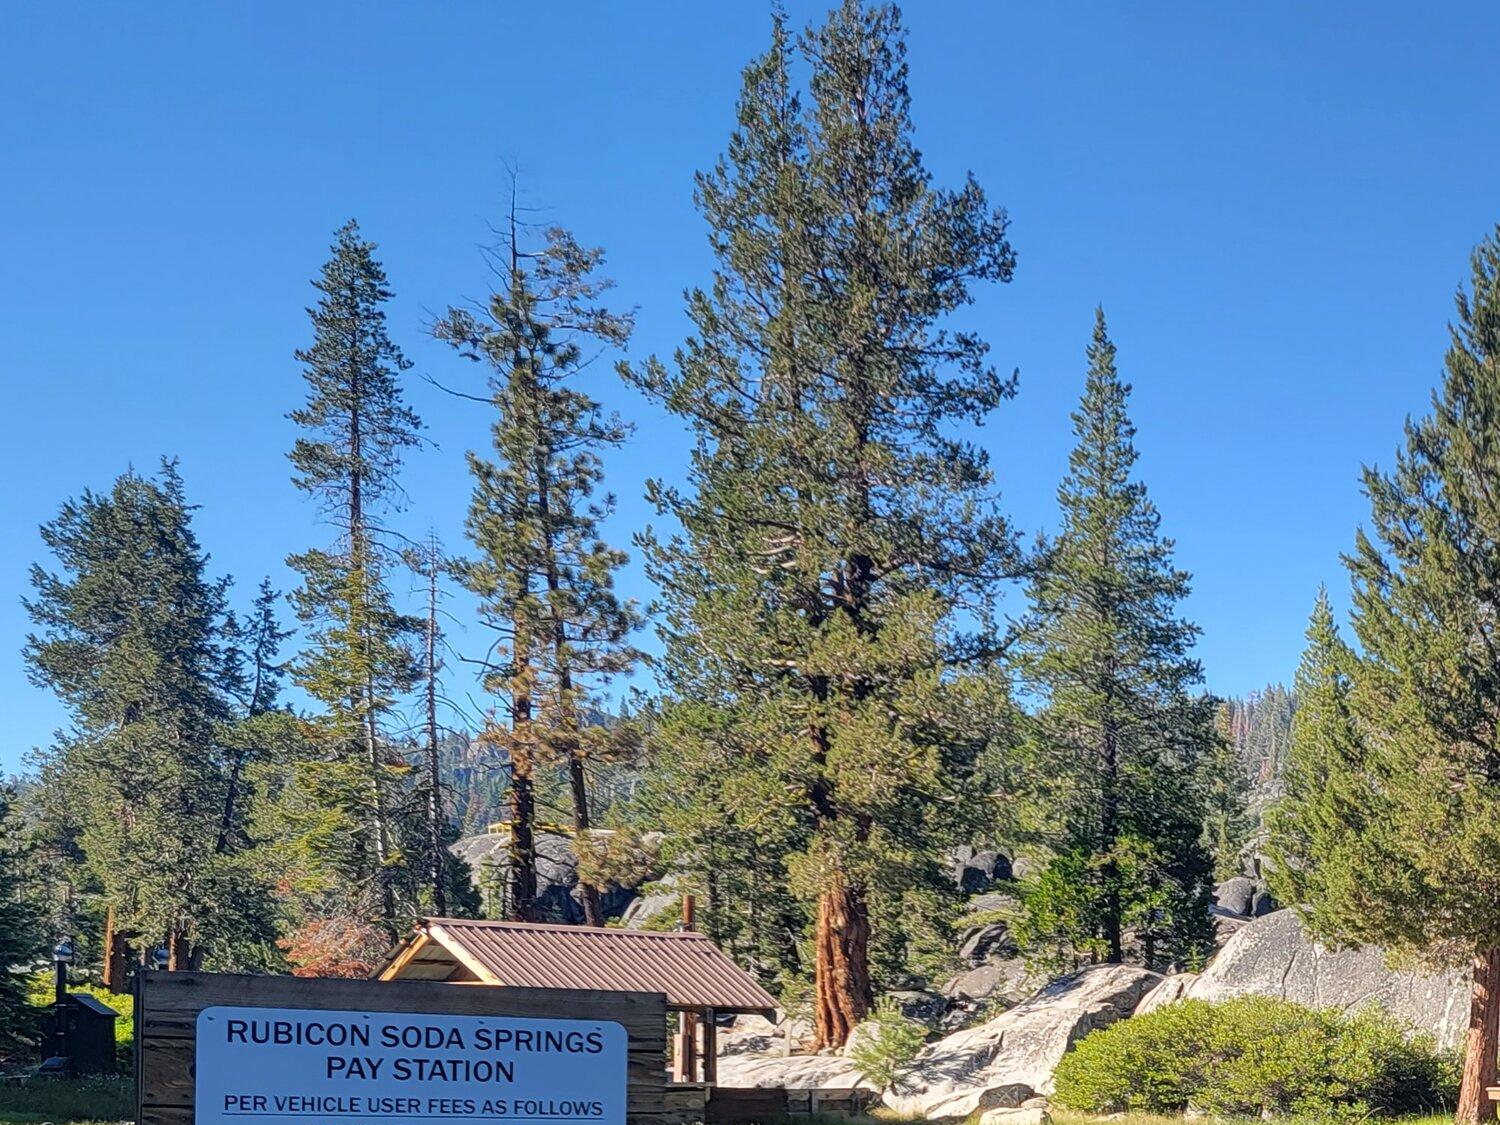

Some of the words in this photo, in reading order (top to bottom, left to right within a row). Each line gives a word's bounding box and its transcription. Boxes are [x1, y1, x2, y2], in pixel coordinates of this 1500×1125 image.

[227, 1020, 370, 1047] RUBICON
[380, 1025, 466, 1050] SODA
[473, 1028, 603, 1054] SPRINGS
[327, 1056, 385, 1080] PAY
[392, 1058, 514, 1083] STATION
[224, 1095, 267, 1111] PER
[273, 1096, 361, 1113] VEHICLE
[367, 1097, 421, 1114] USER
[428, 1098, 476, 1114] FEES
[481, 1099, 507, 1115] AS
[514, 1100, 603, 1116] FOLLOWS
